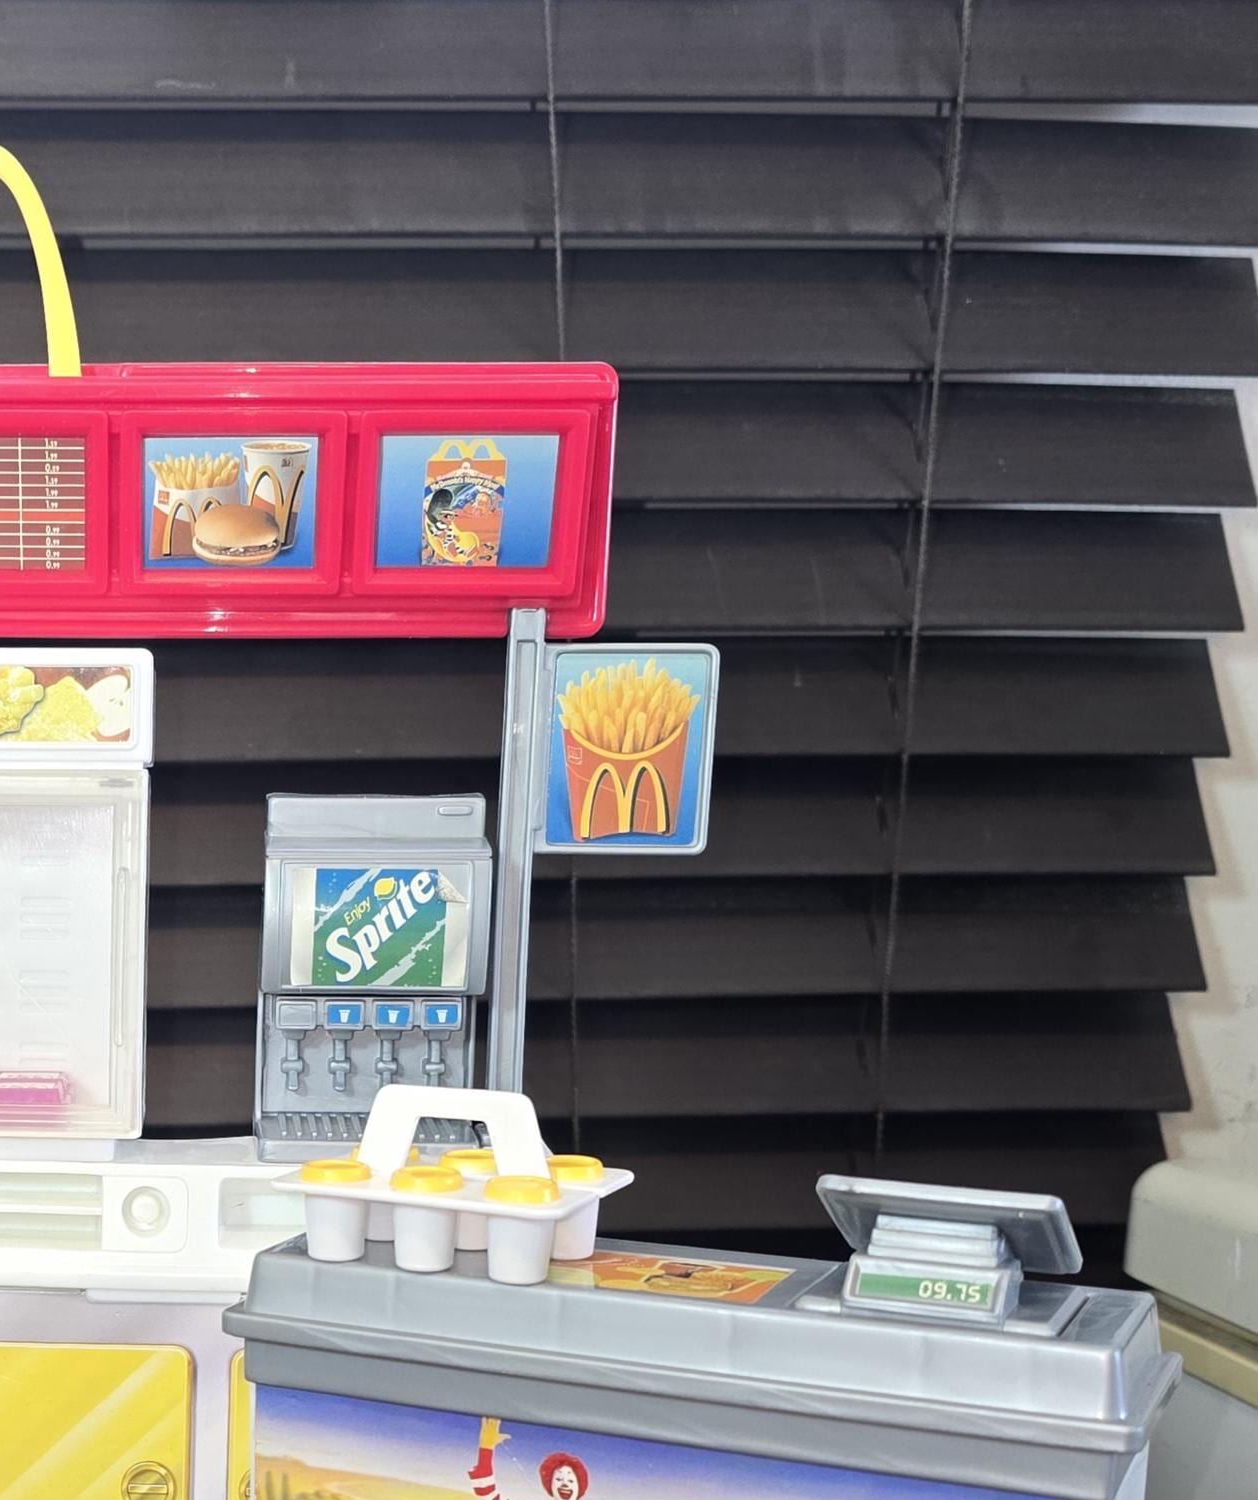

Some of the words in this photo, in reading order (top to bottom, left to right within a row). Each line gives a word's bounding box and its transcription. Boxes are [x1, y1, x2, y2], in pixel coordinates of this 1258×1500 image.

[344, 896, 371, 926] Enjoy
[325, 871, 437, 983] Sprite
[918, 1280, 981, 1303] 09.75
